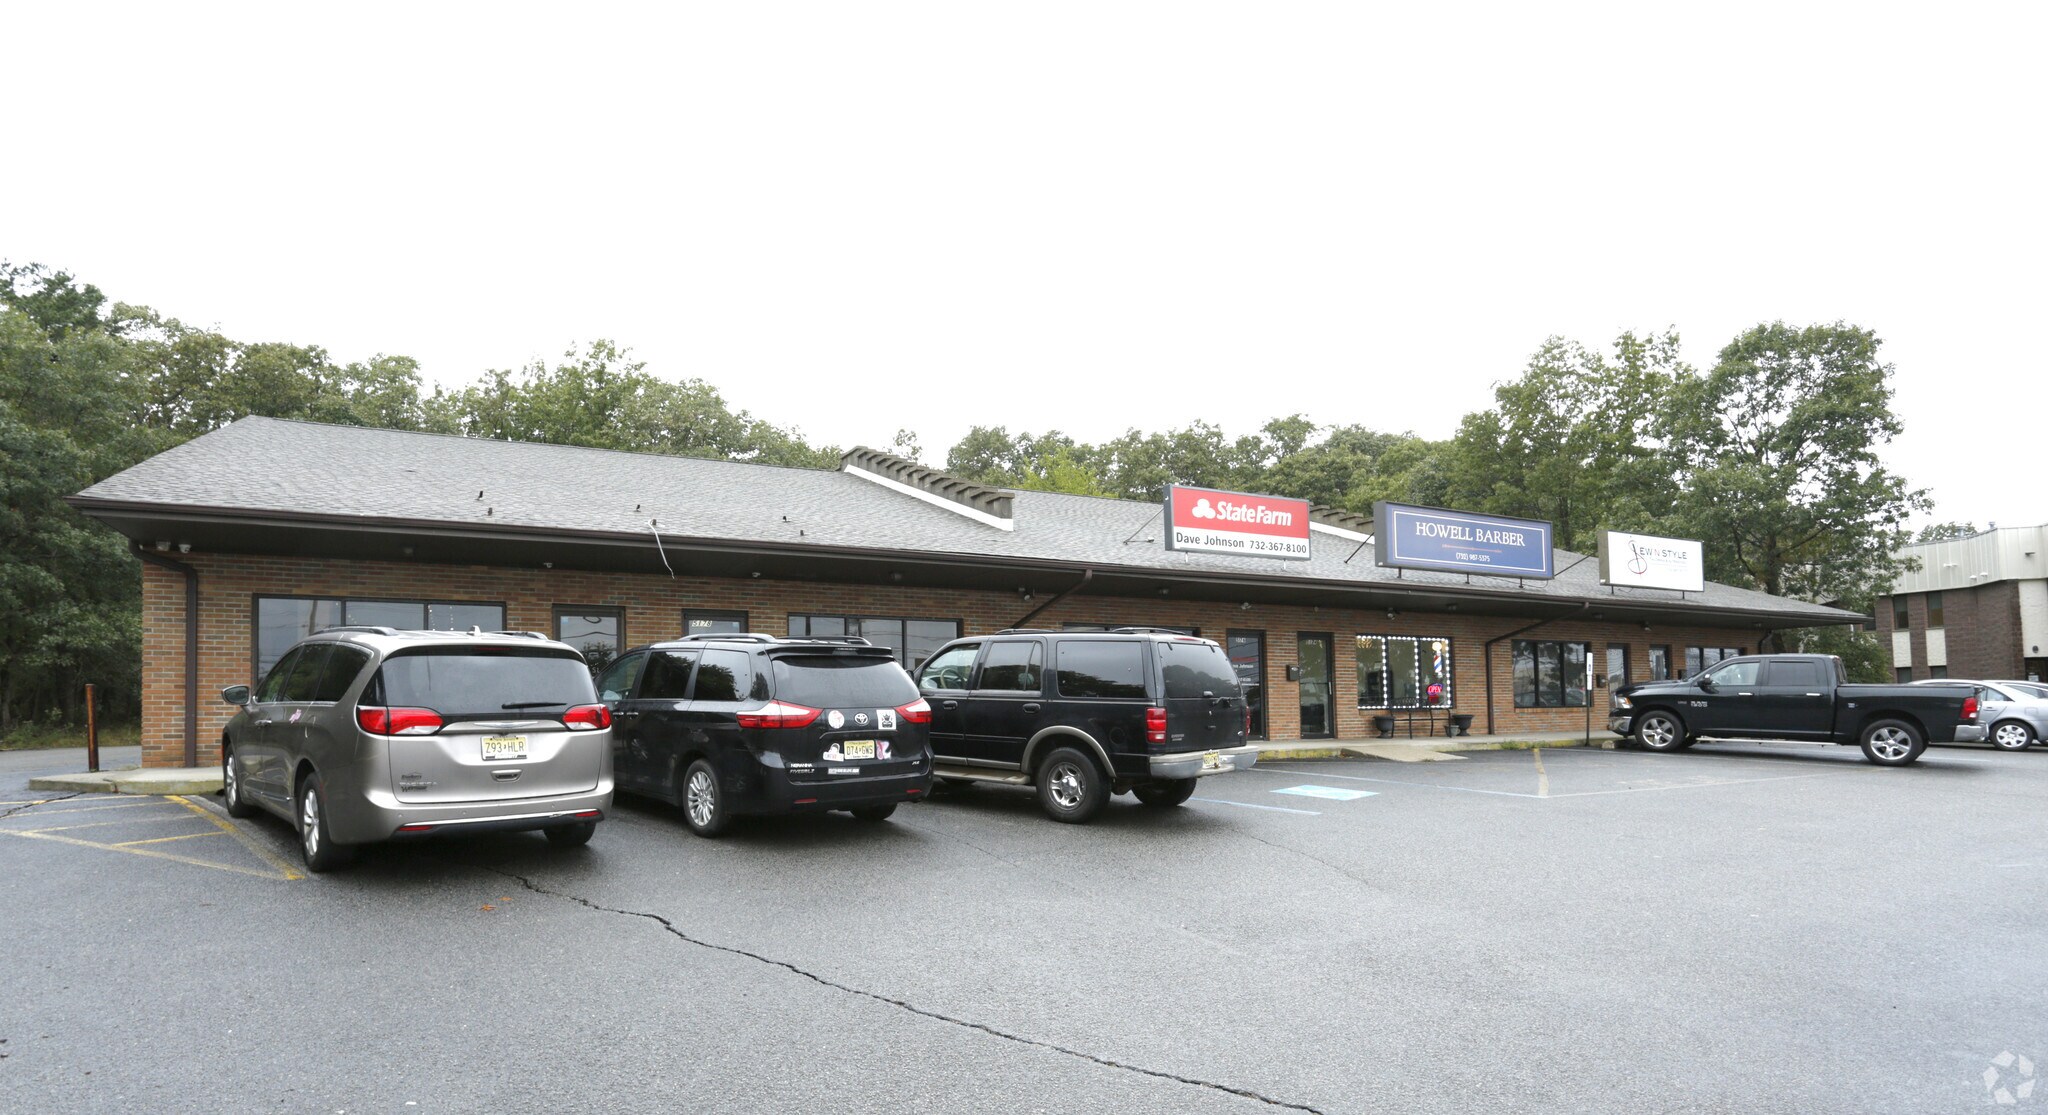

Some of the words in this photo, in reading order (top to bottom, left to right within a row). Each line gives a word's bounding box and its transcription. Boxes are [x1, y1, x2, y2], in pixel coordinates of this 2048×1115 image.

[1415, 522, 1473, 541] HOWELL
[1475, 528, 1526, 547] BARBER
[1176, 532, 1201, 544] Dave
[1203, 535, 1245, 548] Johnson
[1249, 540, 1307, 554] 732-367-8100
[1654, 548, 1661, 557] N
[1662, 549, 1688, 560] STYLE
[1427, 685, 1442, 694] OPEN
[485, 742, 503, 753] Z93
[507, 741, 524, 752] HLR
